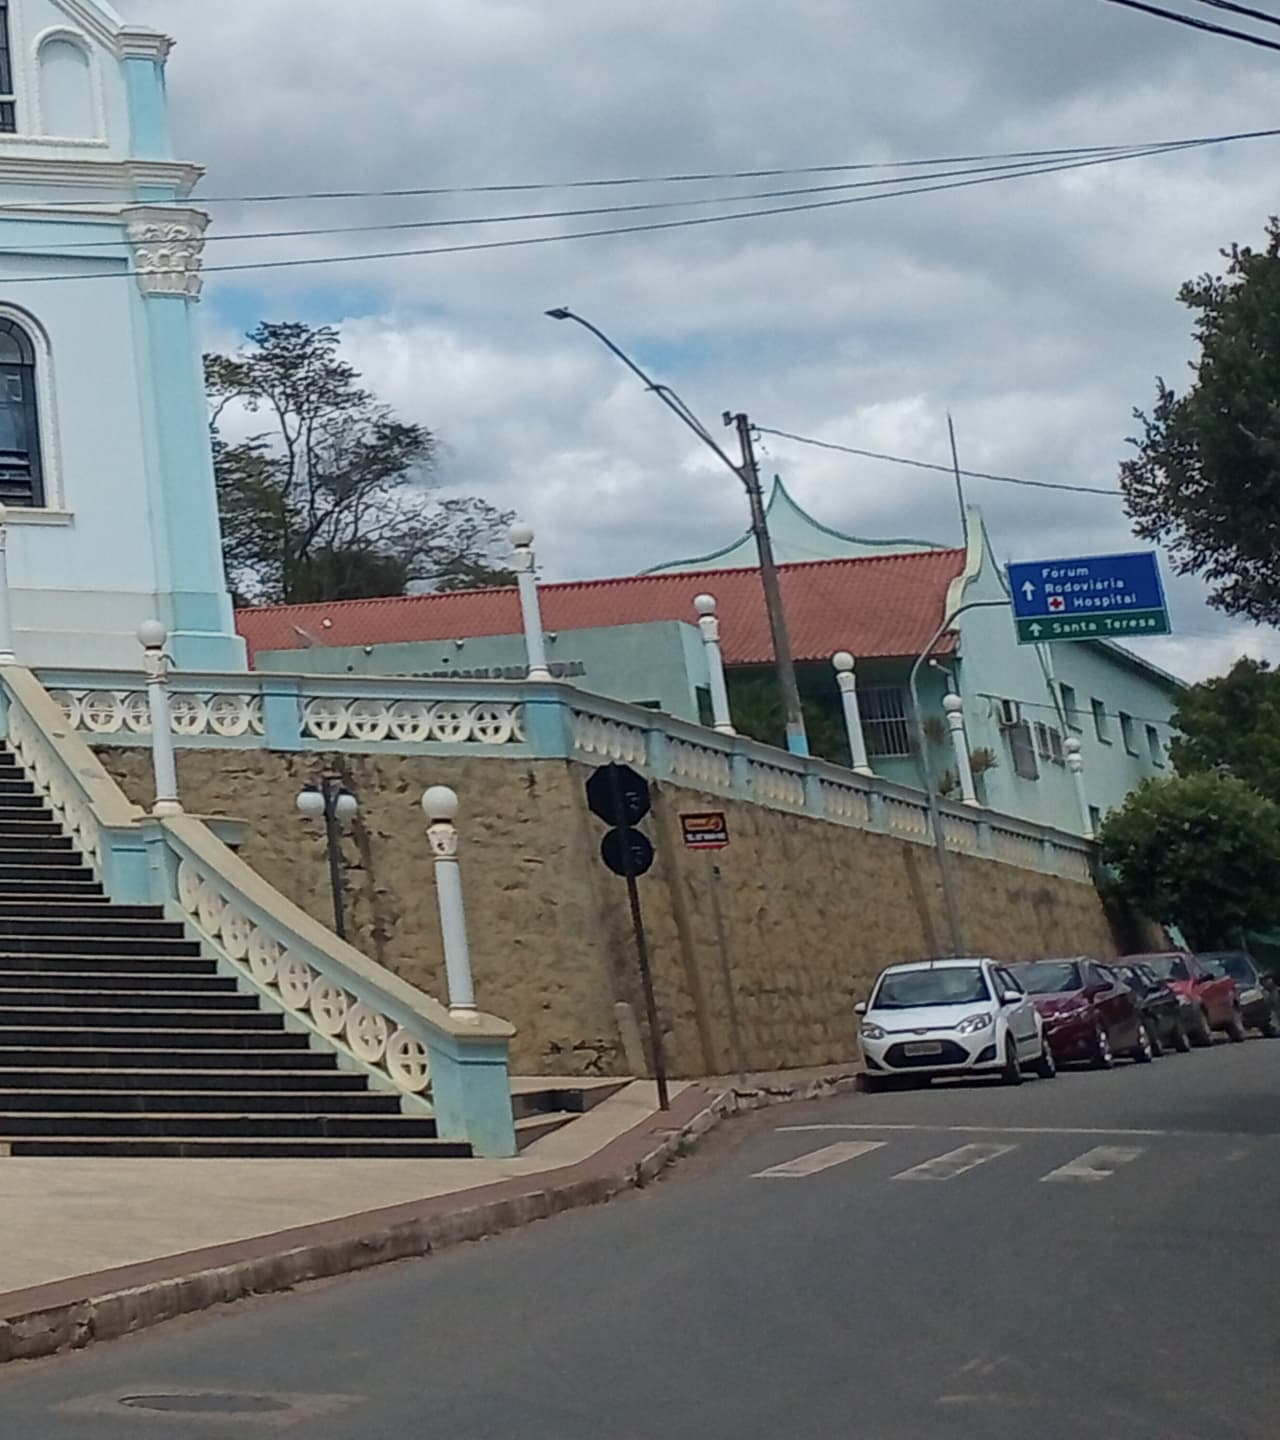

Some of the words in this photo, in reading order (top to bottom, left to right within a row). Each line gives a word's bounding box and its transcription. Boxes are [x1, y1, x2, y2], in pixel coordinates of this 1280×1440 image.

[1042, 566, 1089, 579] Fórum
[1045, 578, 1124, 593] Rodoviária
[1073, 593, 1137, 607] Hospital
[1052, 621, 1097, 634] Santa
[1105, 617, 1156, 629] Teresa
